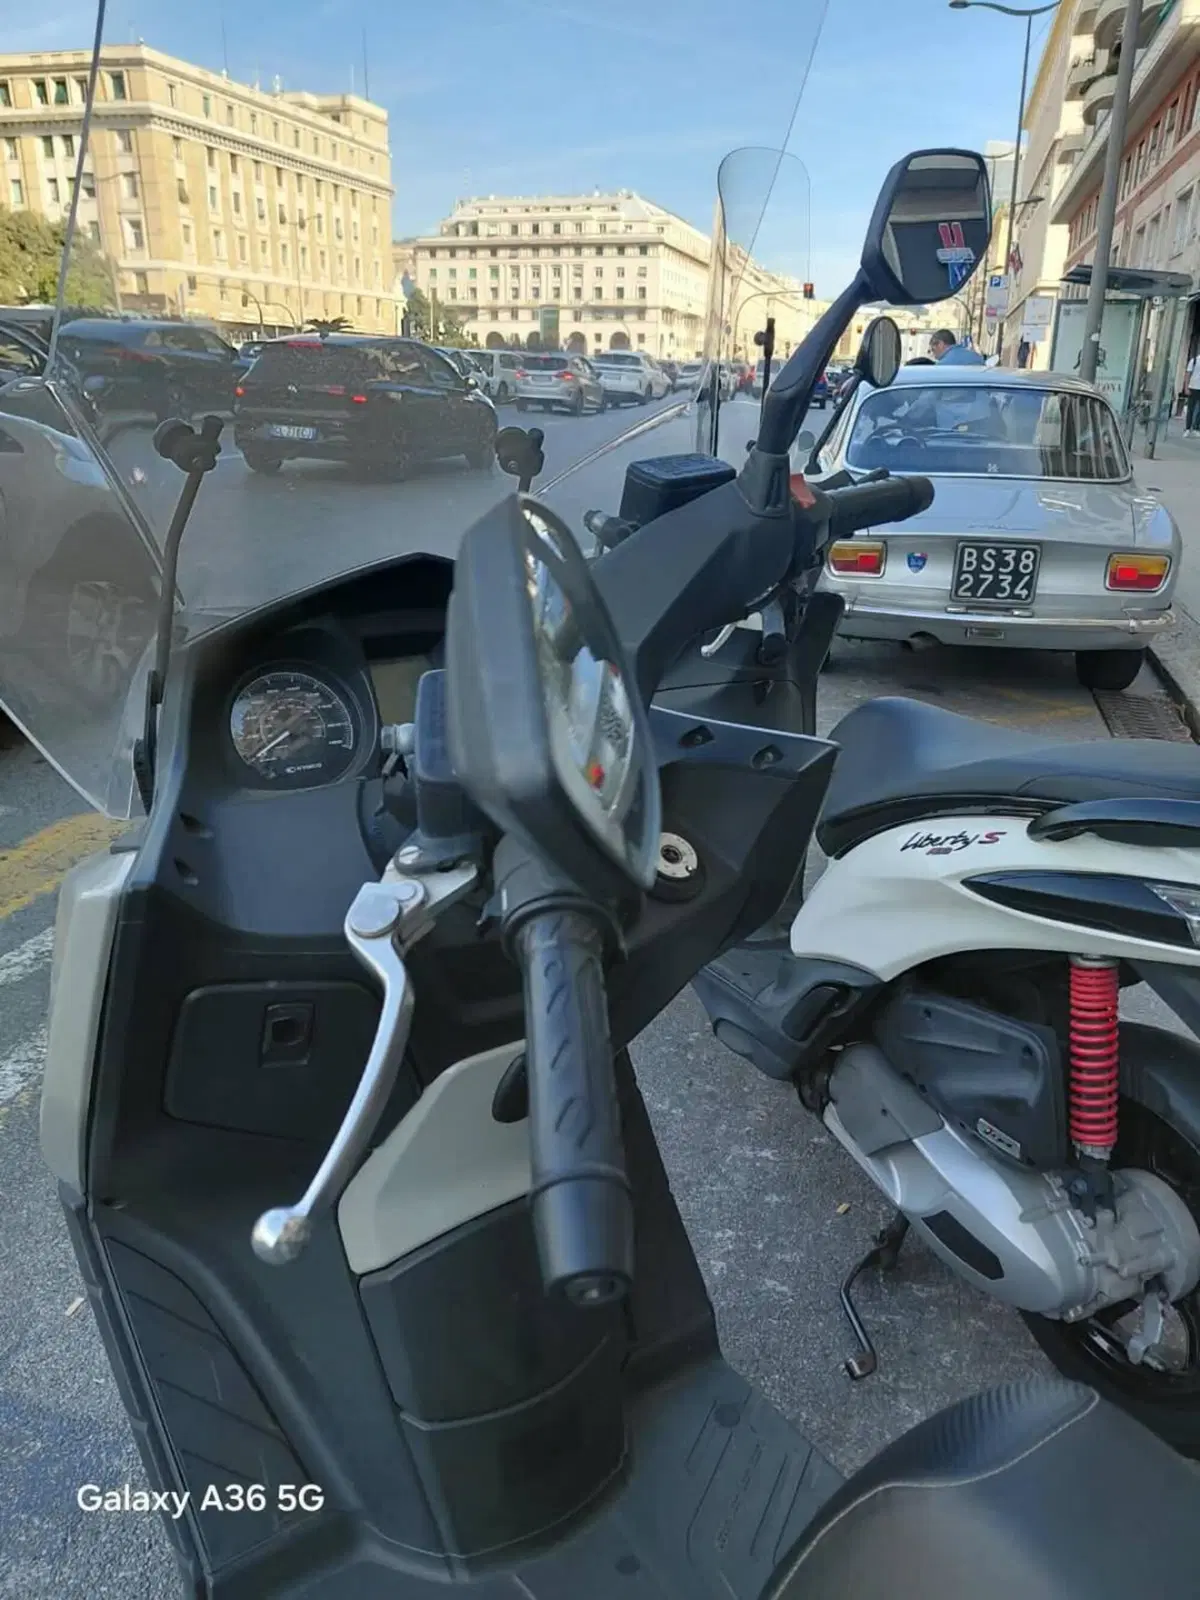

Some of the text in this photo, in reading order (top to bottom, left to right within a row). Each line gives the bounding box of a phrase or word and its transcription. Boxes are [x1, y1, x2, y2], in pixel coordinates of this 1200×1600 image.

[962, 547, 1035, 574] BS38
[957, 573, 1031, 599] 2734
[900, 831, 980, 852] Liberty
[977, 831, 1008, 845] S
